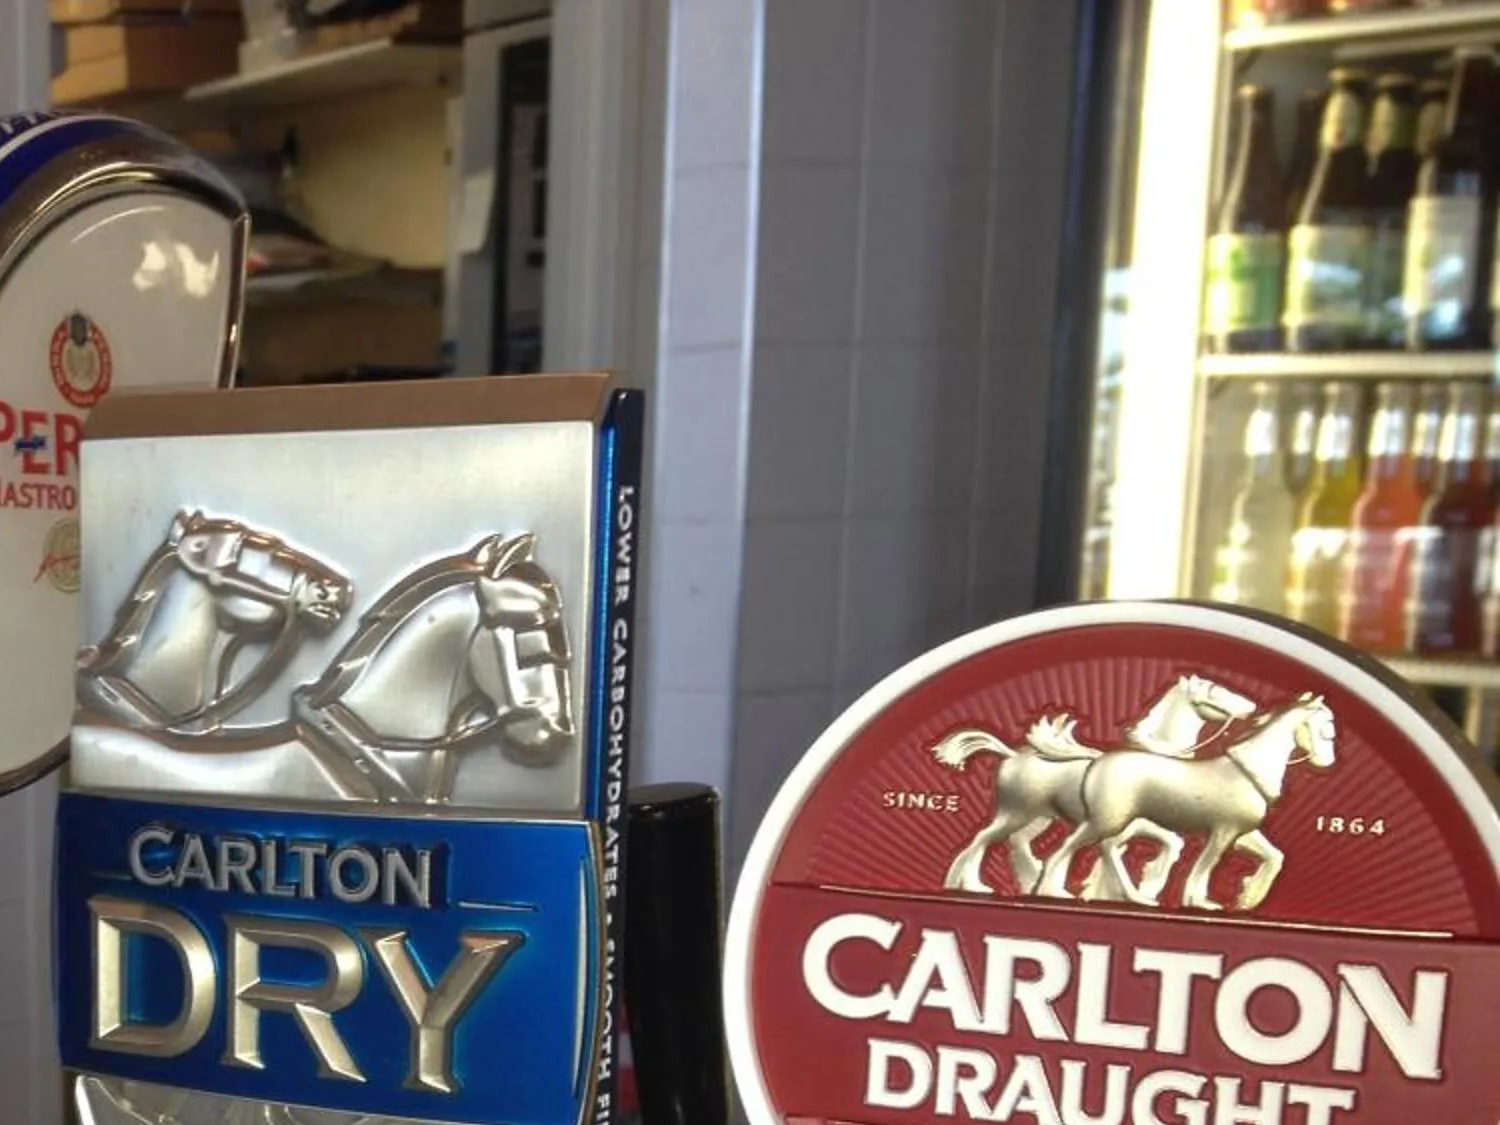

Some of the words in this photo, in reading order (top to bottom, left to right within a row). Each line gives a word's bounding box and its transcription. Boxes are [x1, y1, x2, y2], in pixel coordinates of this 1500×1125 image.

[614, 485, 635, 605] LOWER
[603, 618, 629, 898] CARBOHYDRATES
[882, 790, 960, 814] SINCE
[129, 824, 434, 908] CARLTON
[1315, 815, 1387, 837] 1864
[87, 894, 530, 1096] DRY
[802, 912, 1449, 1081] CARLTON
